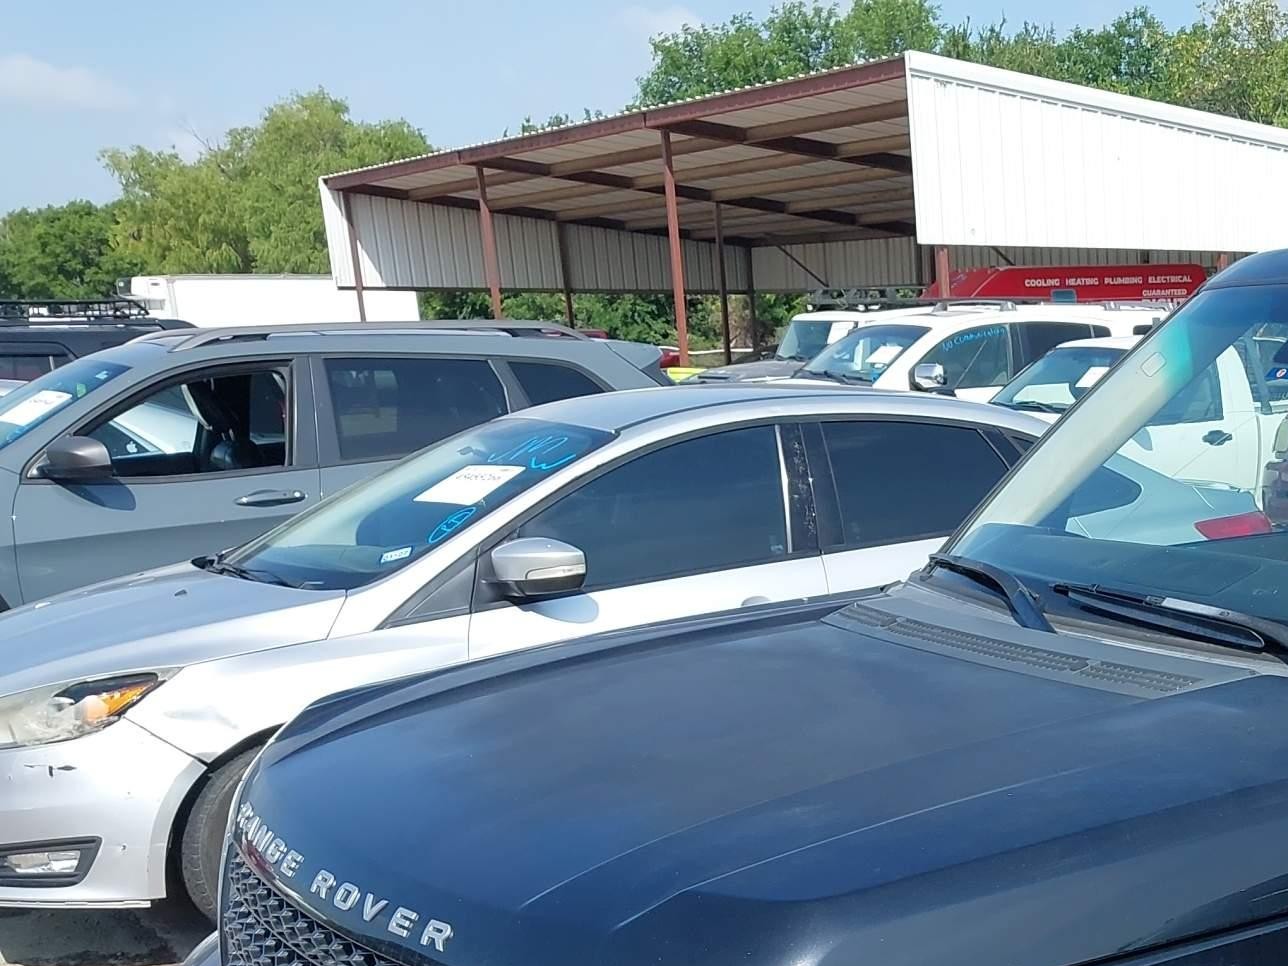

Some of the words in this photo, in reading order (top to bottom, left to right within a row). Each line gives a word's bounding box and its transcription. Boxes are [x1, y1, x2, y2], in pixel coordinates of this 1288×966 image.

[1025, 278, 1060, 287] COOLING
[1066, 277, 1099, 286] HEATING
[1104, 276, 1143, 285] PLUMBING
[1148, 275, 1192, 284] ELECTRICAL
[1142, 288, 1188, 297] GUARANTEED
[237, 801, 305, 877] RANGE
[310, 869, 454, 953] ROVER
